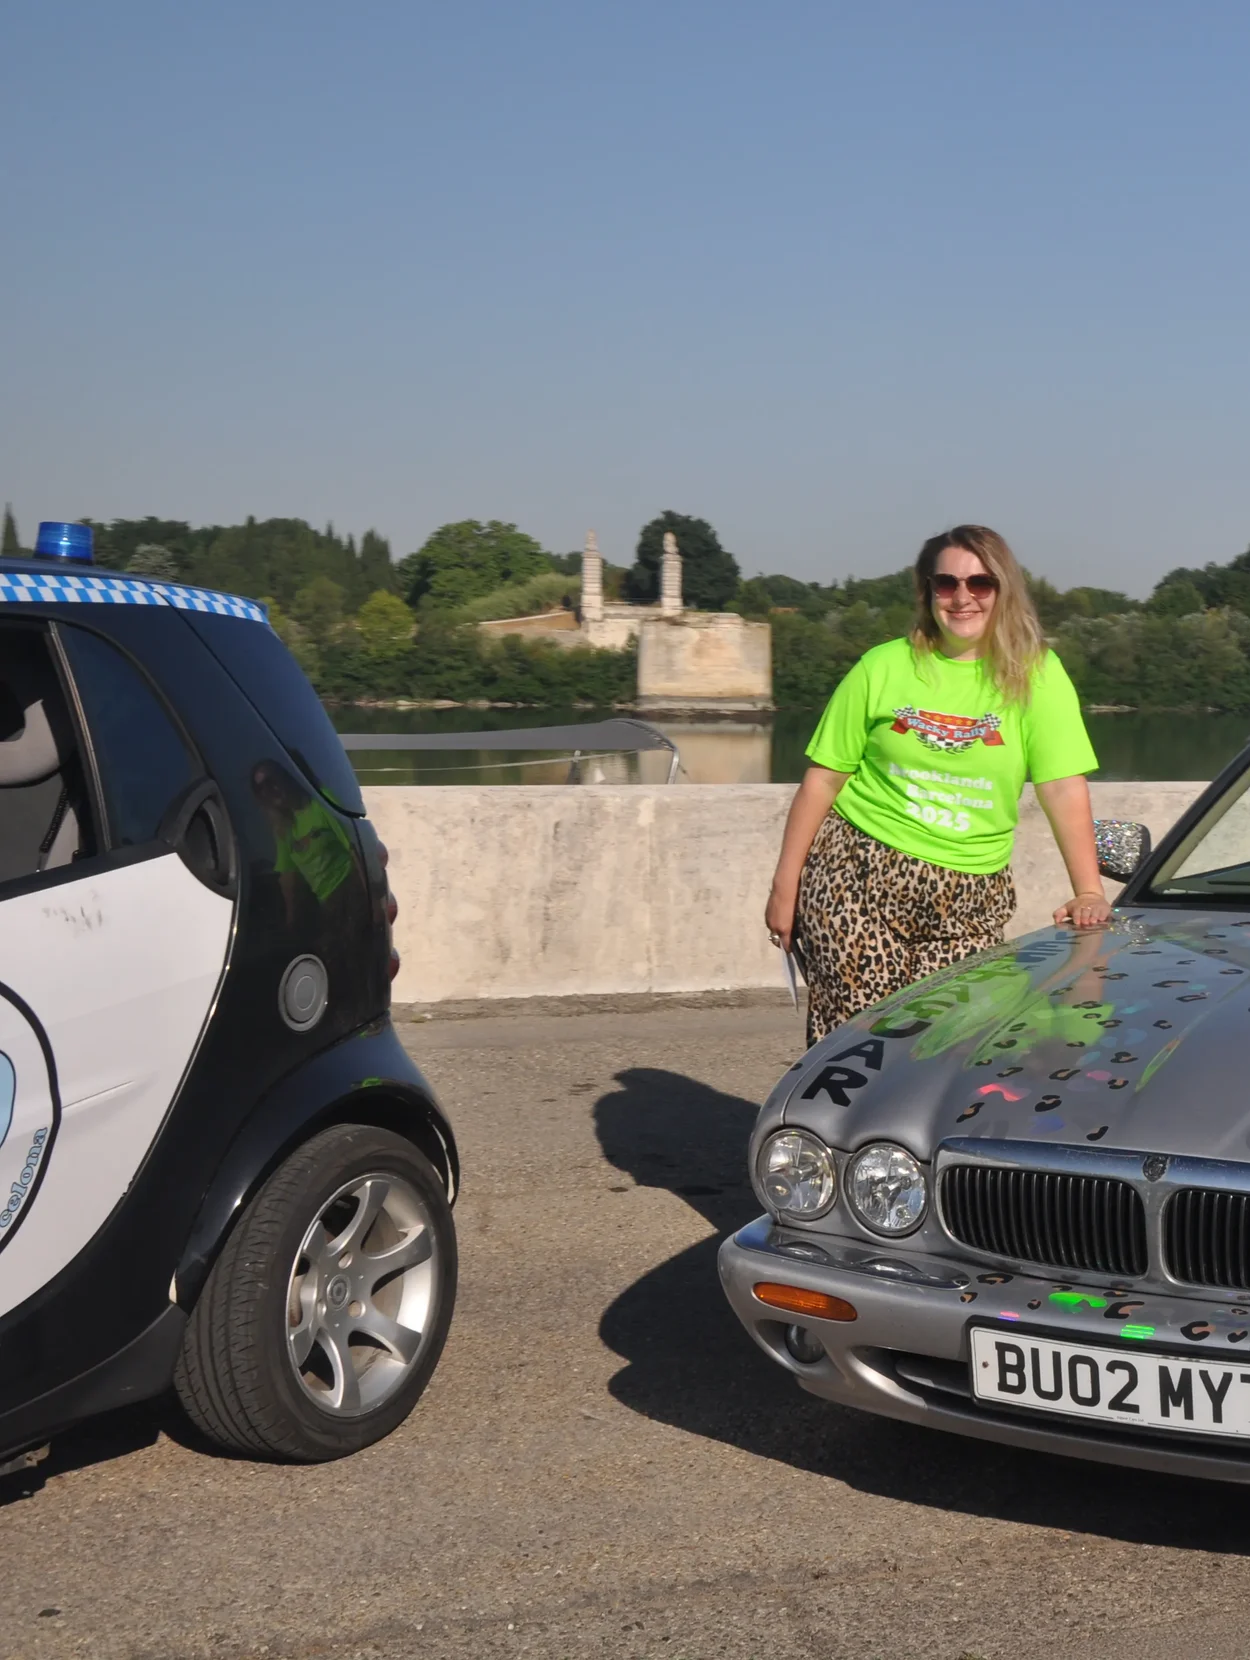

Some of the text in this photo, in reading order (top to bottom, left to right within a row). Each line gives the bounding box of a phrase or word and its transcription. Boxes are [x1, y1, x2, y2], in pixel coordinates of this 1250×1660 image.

[907, 717, 986, 739] Wacky Rally
[905, 800, 970, 832] 2025
[994, 1341, 1141, 1414] BU02
